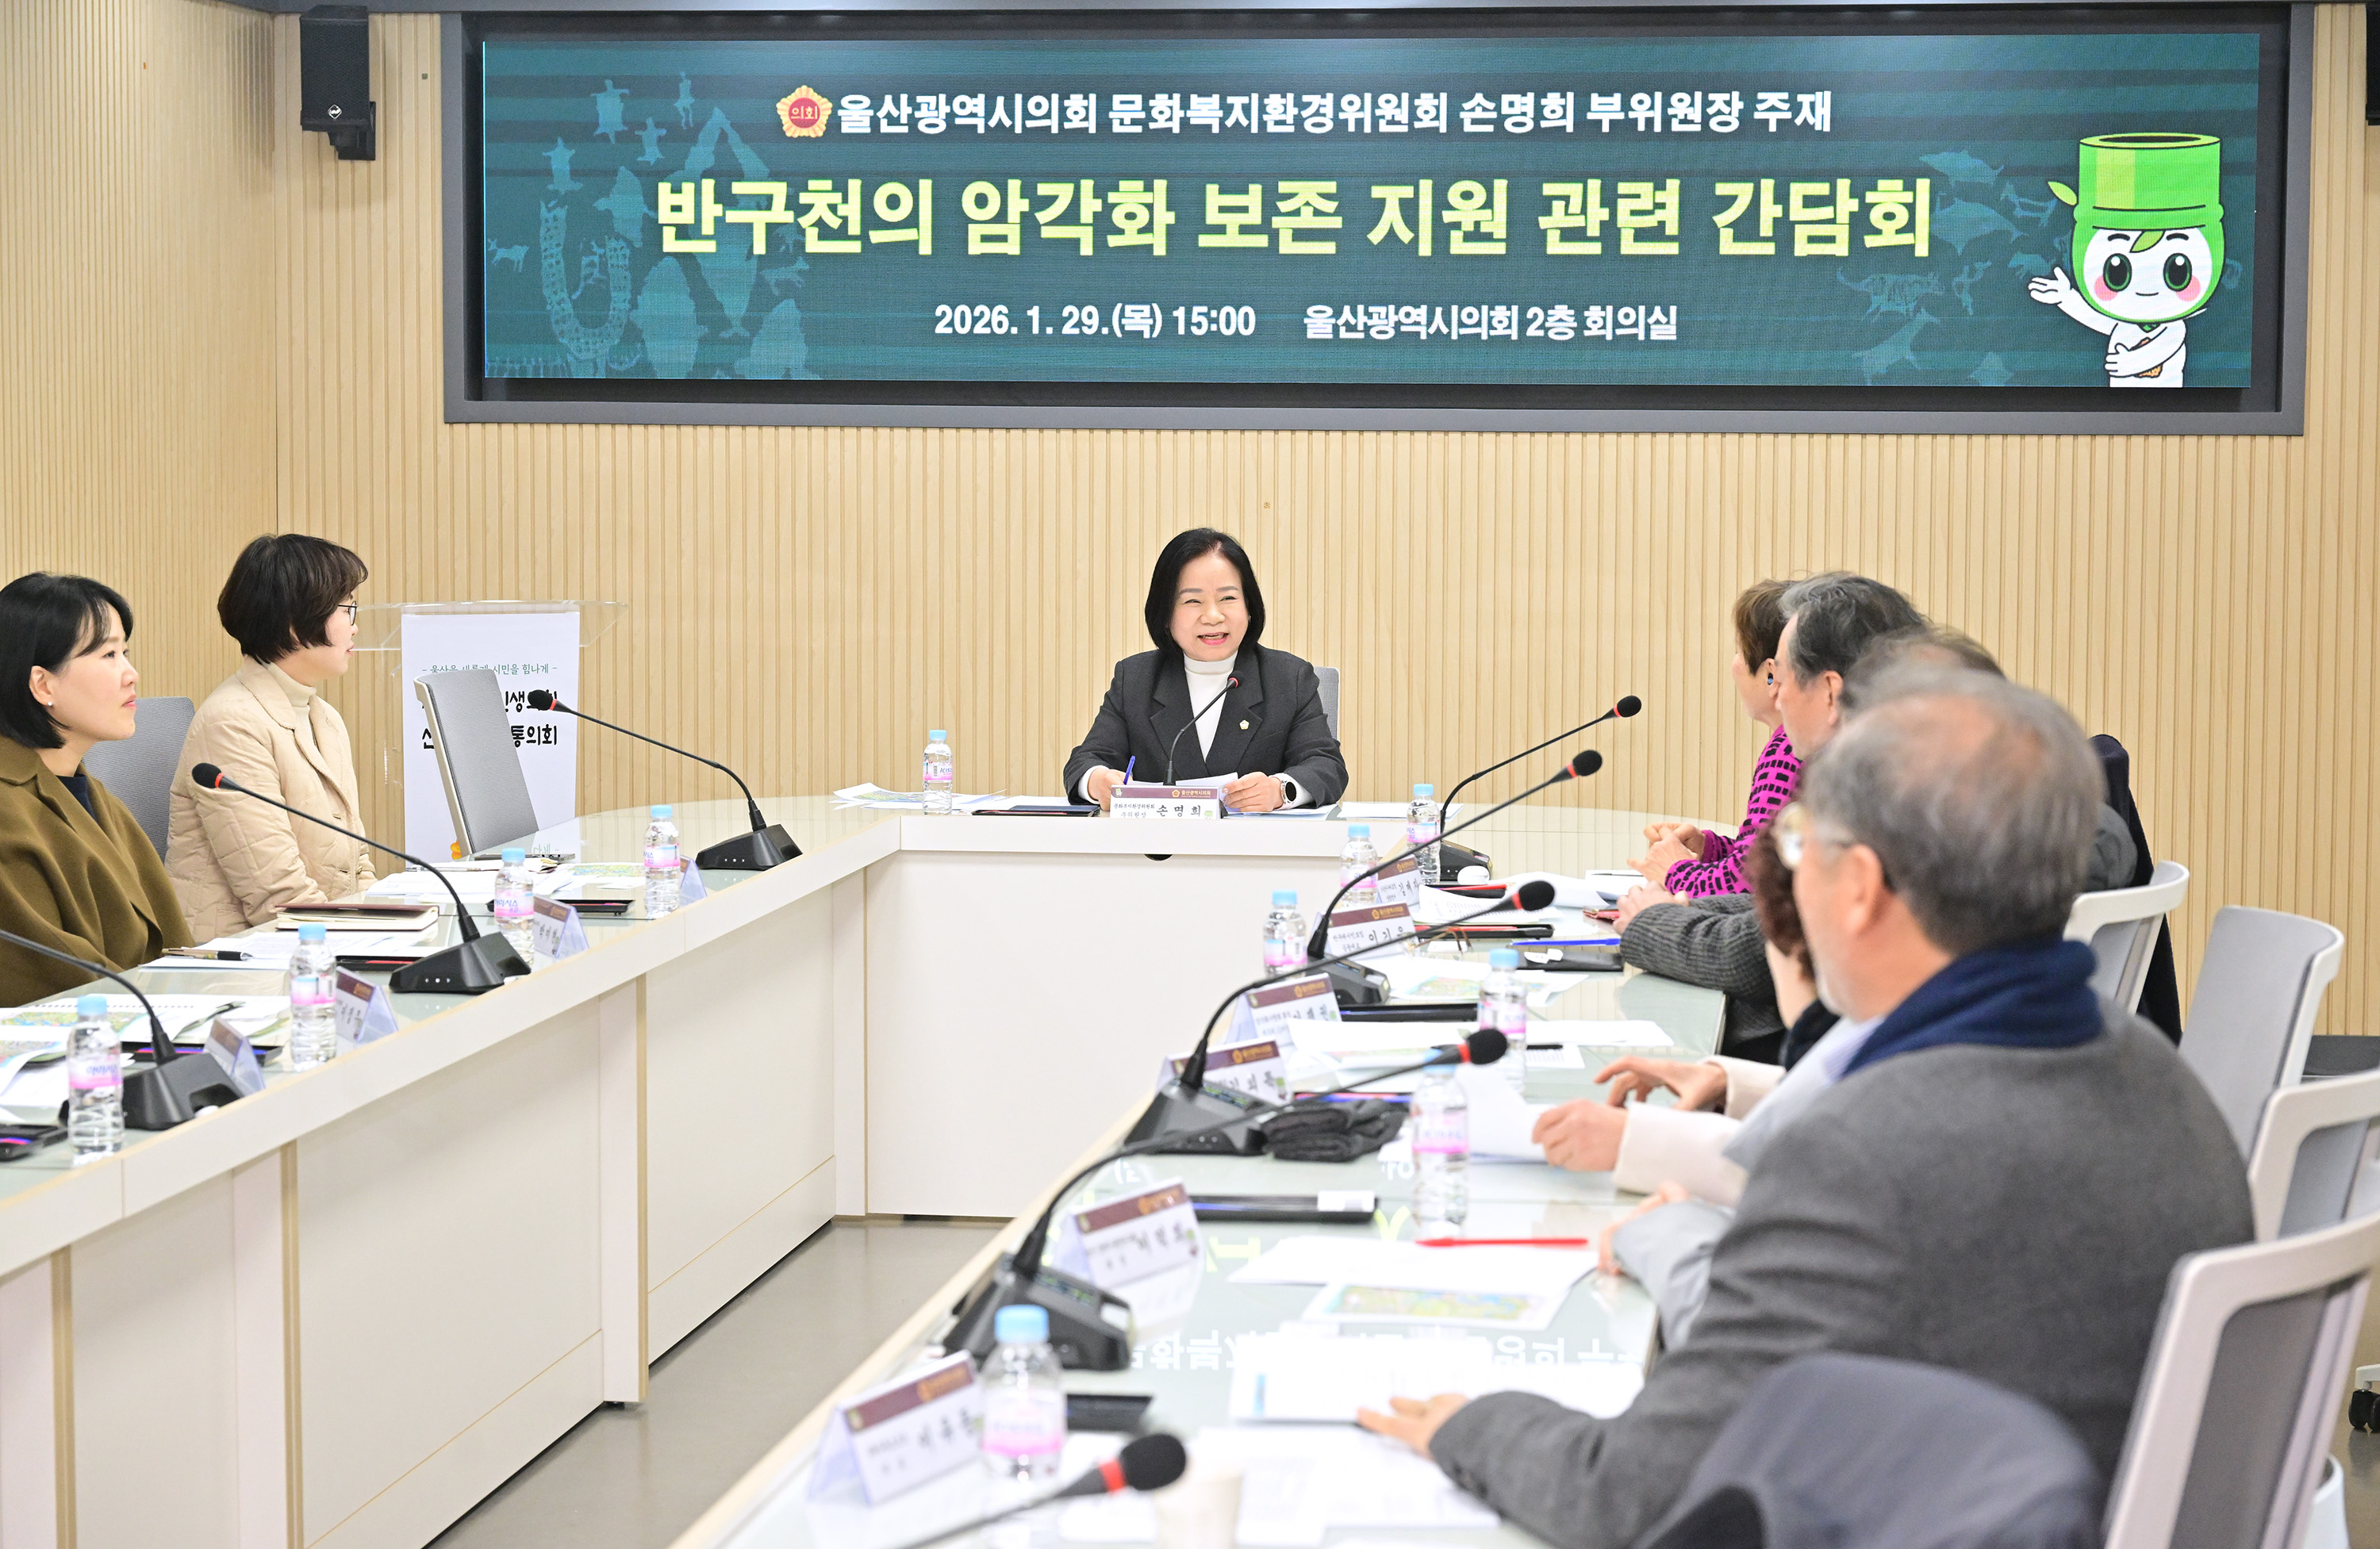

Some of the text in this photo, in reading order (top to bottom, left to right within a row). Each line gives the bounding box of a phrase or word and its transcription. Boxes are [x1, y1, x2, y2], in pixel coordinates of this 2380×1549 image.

[790, 105, 818, 120] 의회
[838, 90, 1832, 134] 울산광역시의회 문화복지환경위원회 손명희 부위원장 주재
[657, 178, 1931, 257] 반구천의 암각화 보존 지원 관련 간담회
[935, 302, 1256, 339] 2026. 1. 29.(목) 15:00
[1303, 304, 1677, 341] 울산광역시의회 2층 회의실
[493, 663, 520, 675] 시민을
[521, 662, 550, 675] 힘나게
[510, 723, 558, 748] 통의회
